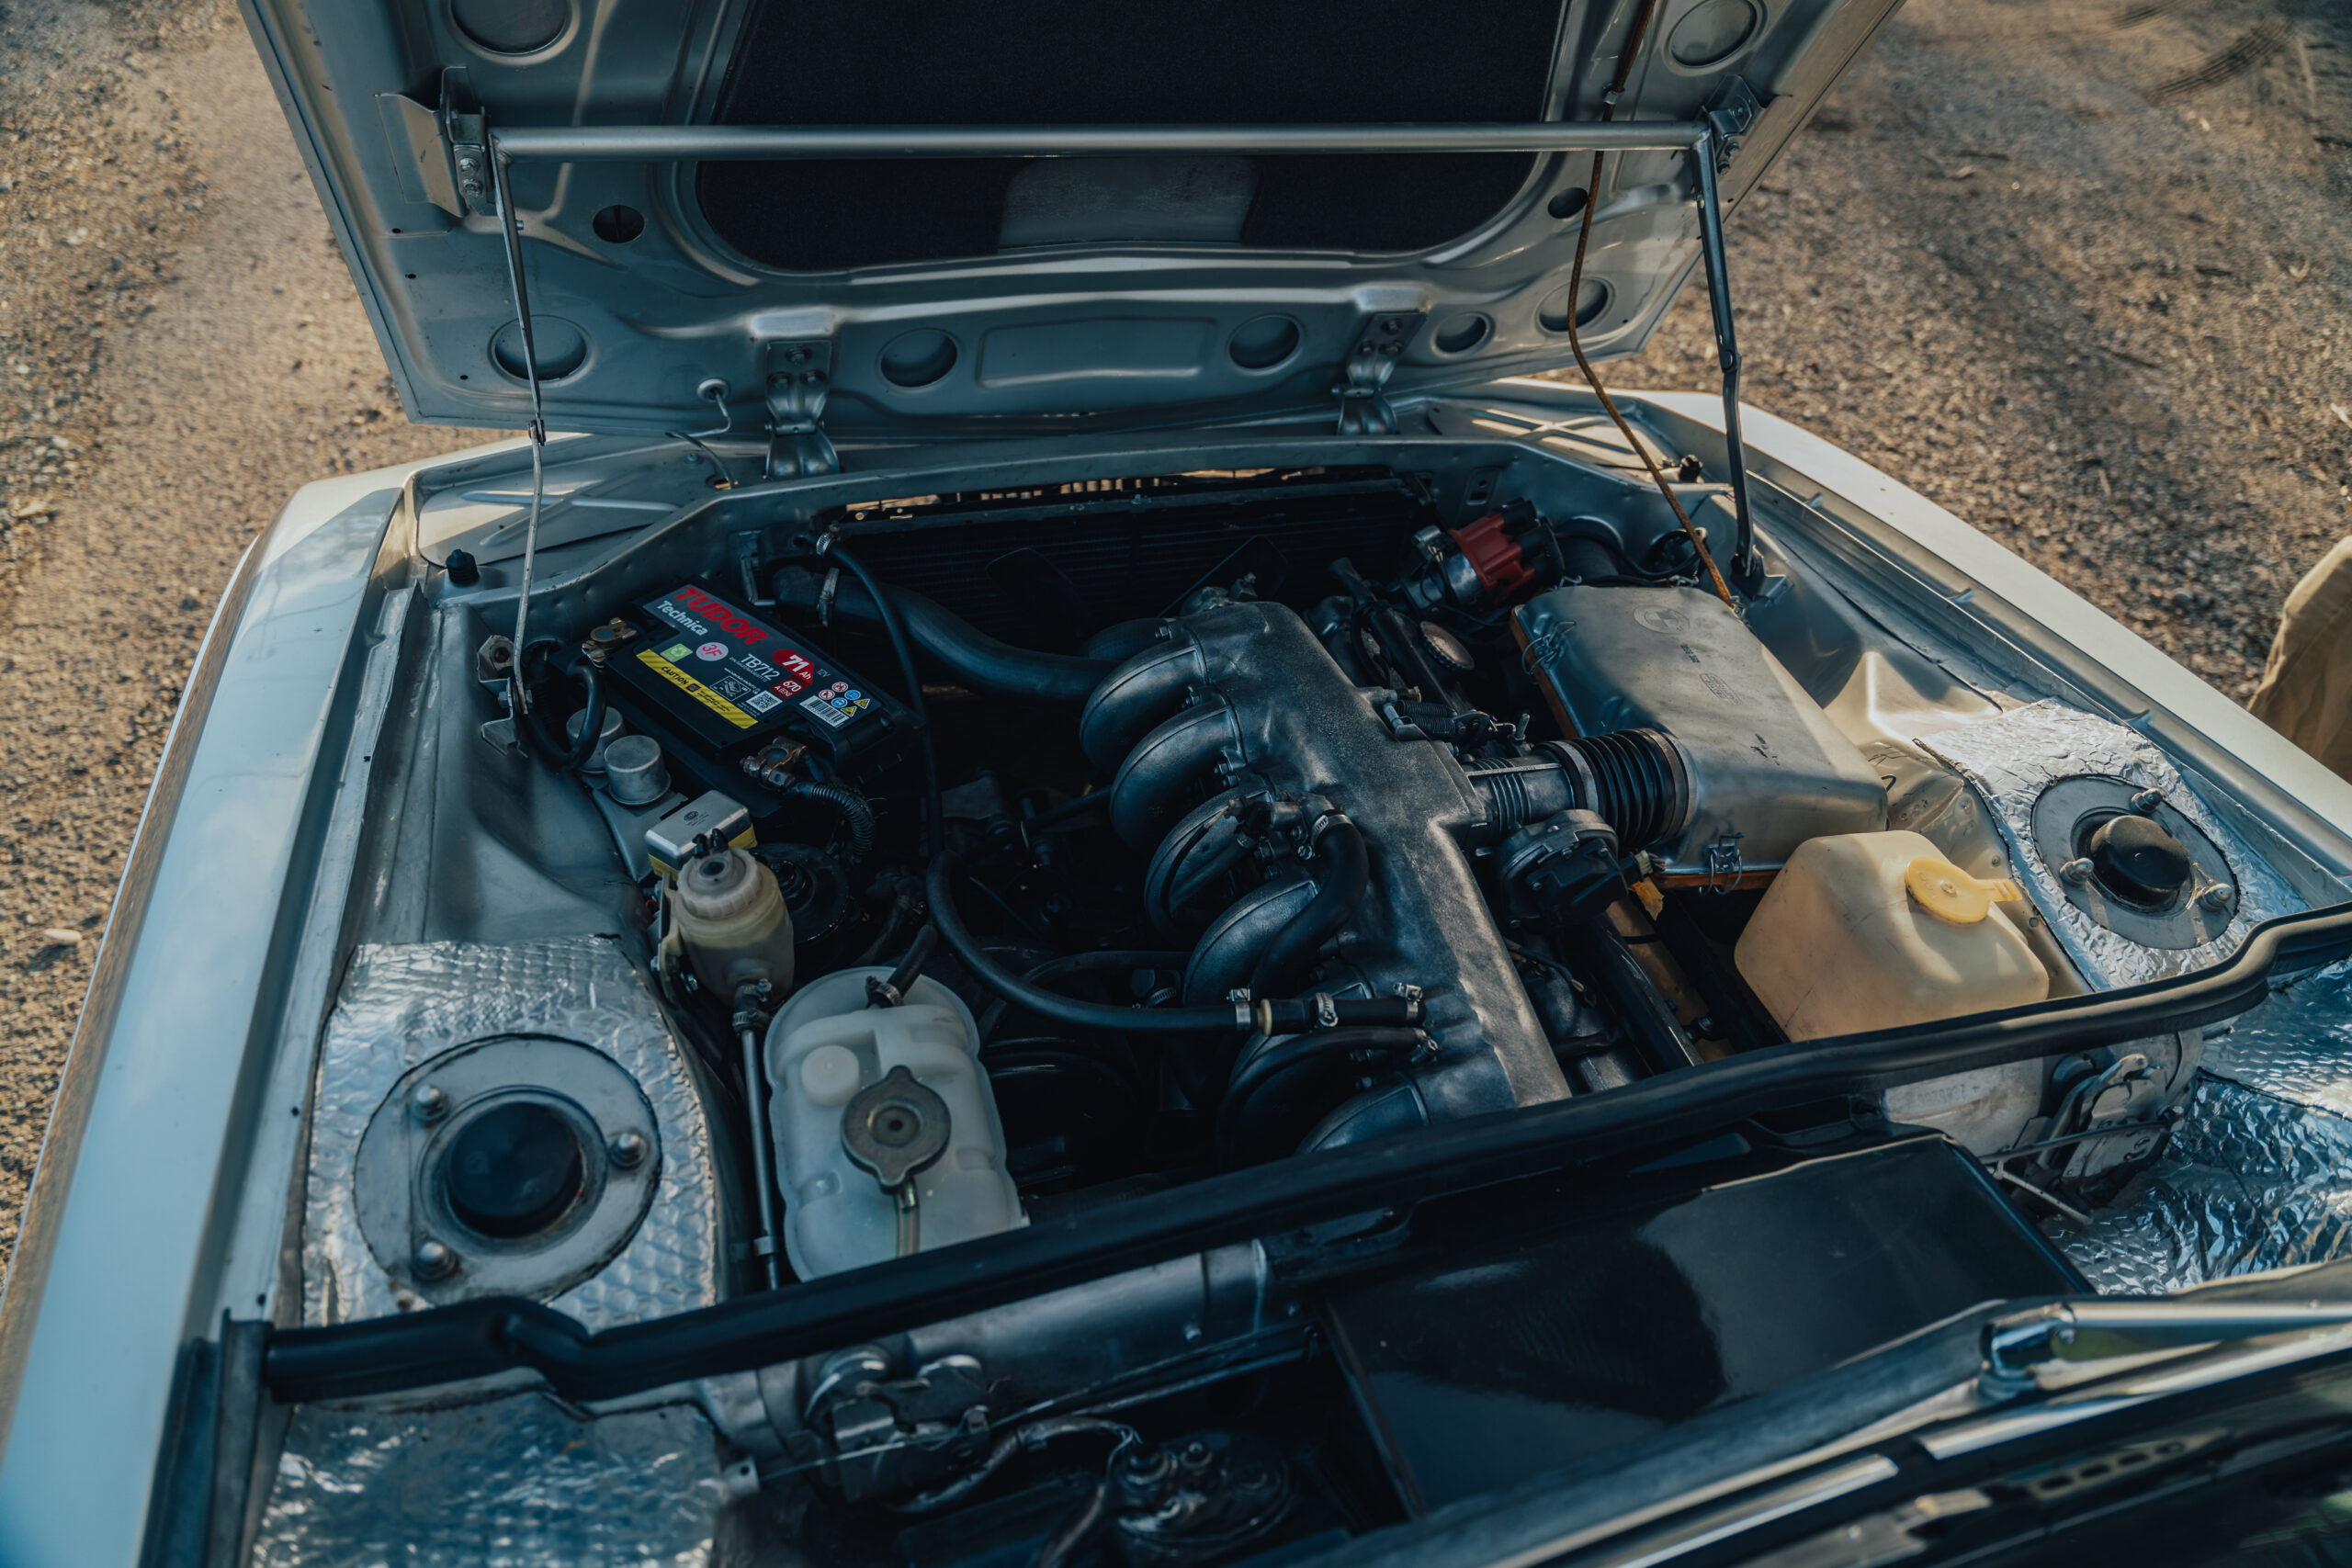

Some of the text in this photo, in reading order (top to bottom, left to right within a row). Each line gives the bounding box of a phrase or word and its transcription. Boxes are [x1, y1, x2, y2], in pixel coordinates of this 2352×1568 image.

[657, 600, 708, 636] Technica
[673, 586, 768, 645] TUDOR
[662, 666, 690, 685] CAUTION
[741, 653, 780, 681] TB712
[782, 654, 812, 680] 71 Ah
[783, 681, 802, 692] 670
